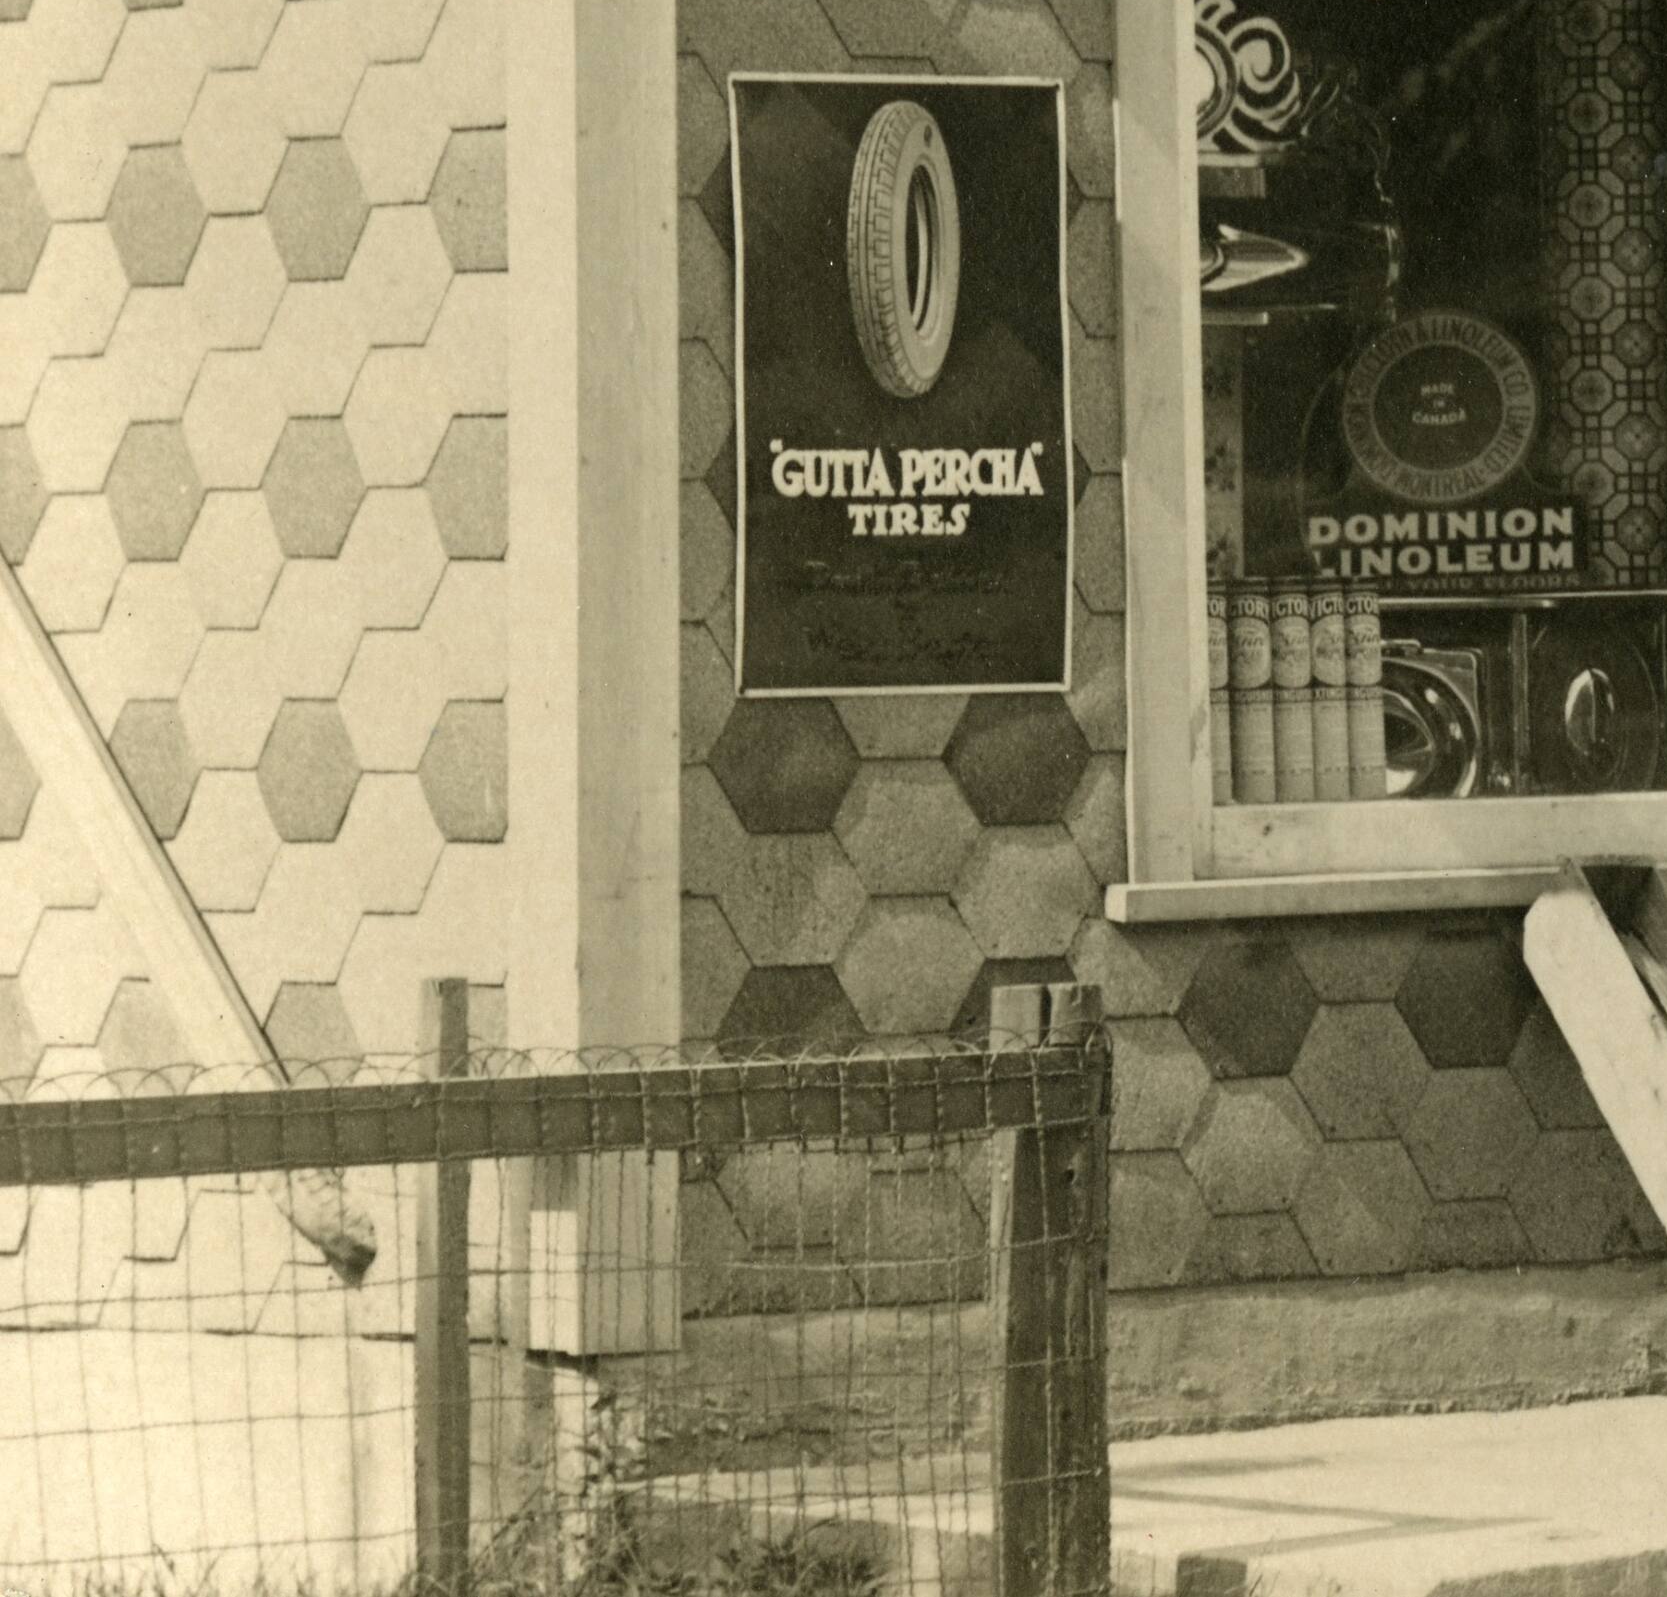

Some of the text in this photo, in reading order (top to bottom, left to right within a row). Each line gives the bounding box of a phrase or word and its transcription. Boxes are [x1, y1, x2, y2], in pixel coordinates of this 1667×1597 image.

[1430, 318, 1517, 372] LINOLEUM
[1420, 382, 1455, 397] MADE
[1411, 407, 1467, 425] CANADA
[849, 504, 970, 535] TIRES
[1309, 506, 1574, 545] DOMINION
[1313, 541, 1574, 577] LINOLEUM
